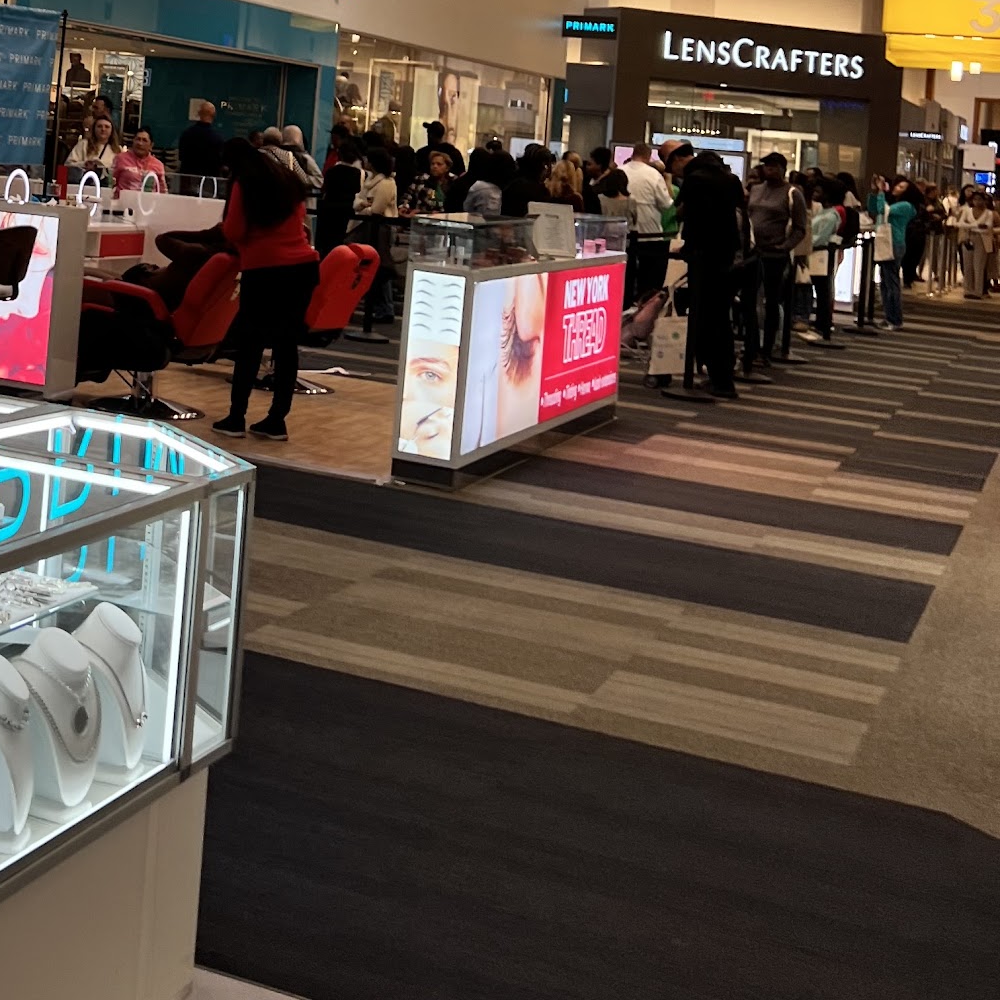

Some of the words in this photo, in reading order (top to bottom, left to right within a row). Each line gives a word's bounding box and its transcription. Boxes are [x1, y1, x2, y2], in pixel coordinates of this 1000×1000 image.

[565, 20, 616, 33] PRIMARK
[9, 53, 42, 66] PRIMARK
[8, 135, 43, 146] PRIMARK
[563, 278, 587, 309] NEW
[585, 273, 609, 305] YORK
